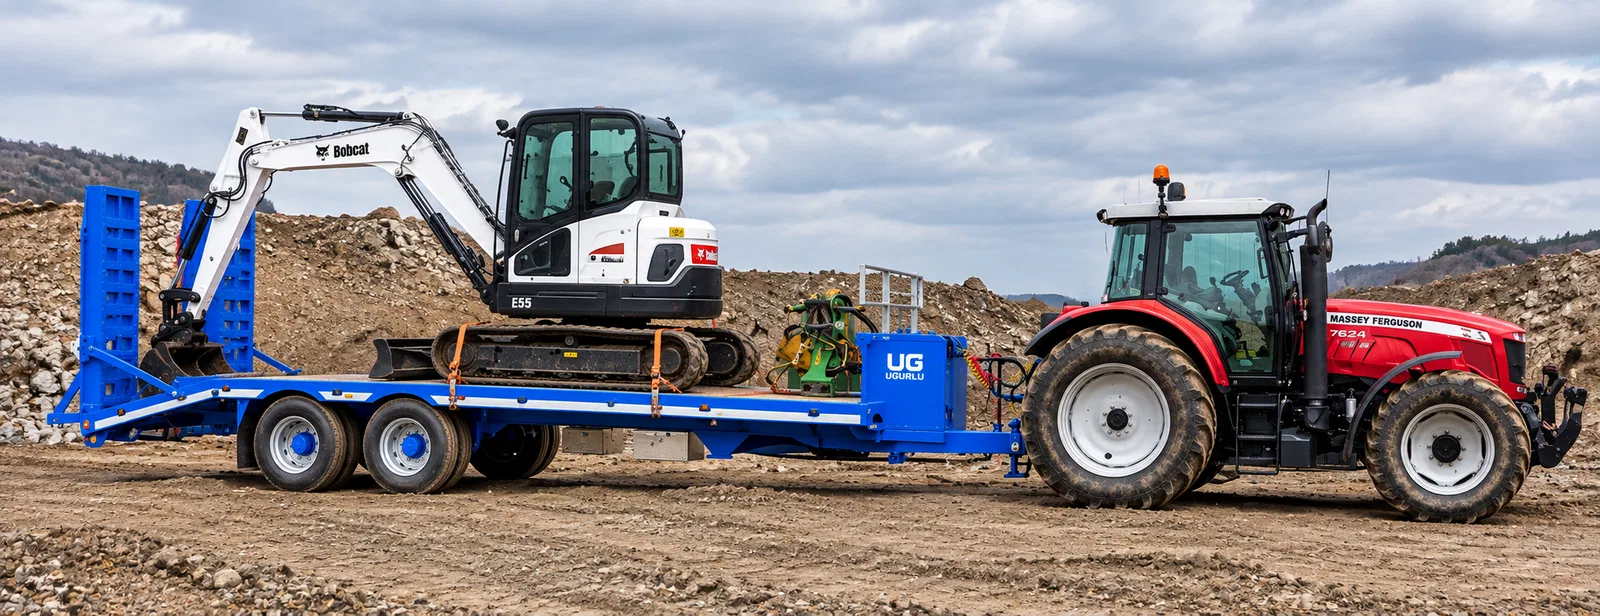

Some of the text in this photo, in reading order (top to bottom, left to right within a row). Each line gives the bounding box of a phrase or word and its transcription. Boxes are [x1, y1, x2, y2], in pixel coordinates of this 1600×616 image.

[333, 142, 370, 158] Bobcat
[511, 297, 532, 309] E55
[1330, 315, 1423, 329] MASSEY FERGUSON
[1330, 329, 1366, 339] 7624
[887, 353, 924, 372] UG
[885, 372, 925, 381] UGURLU
